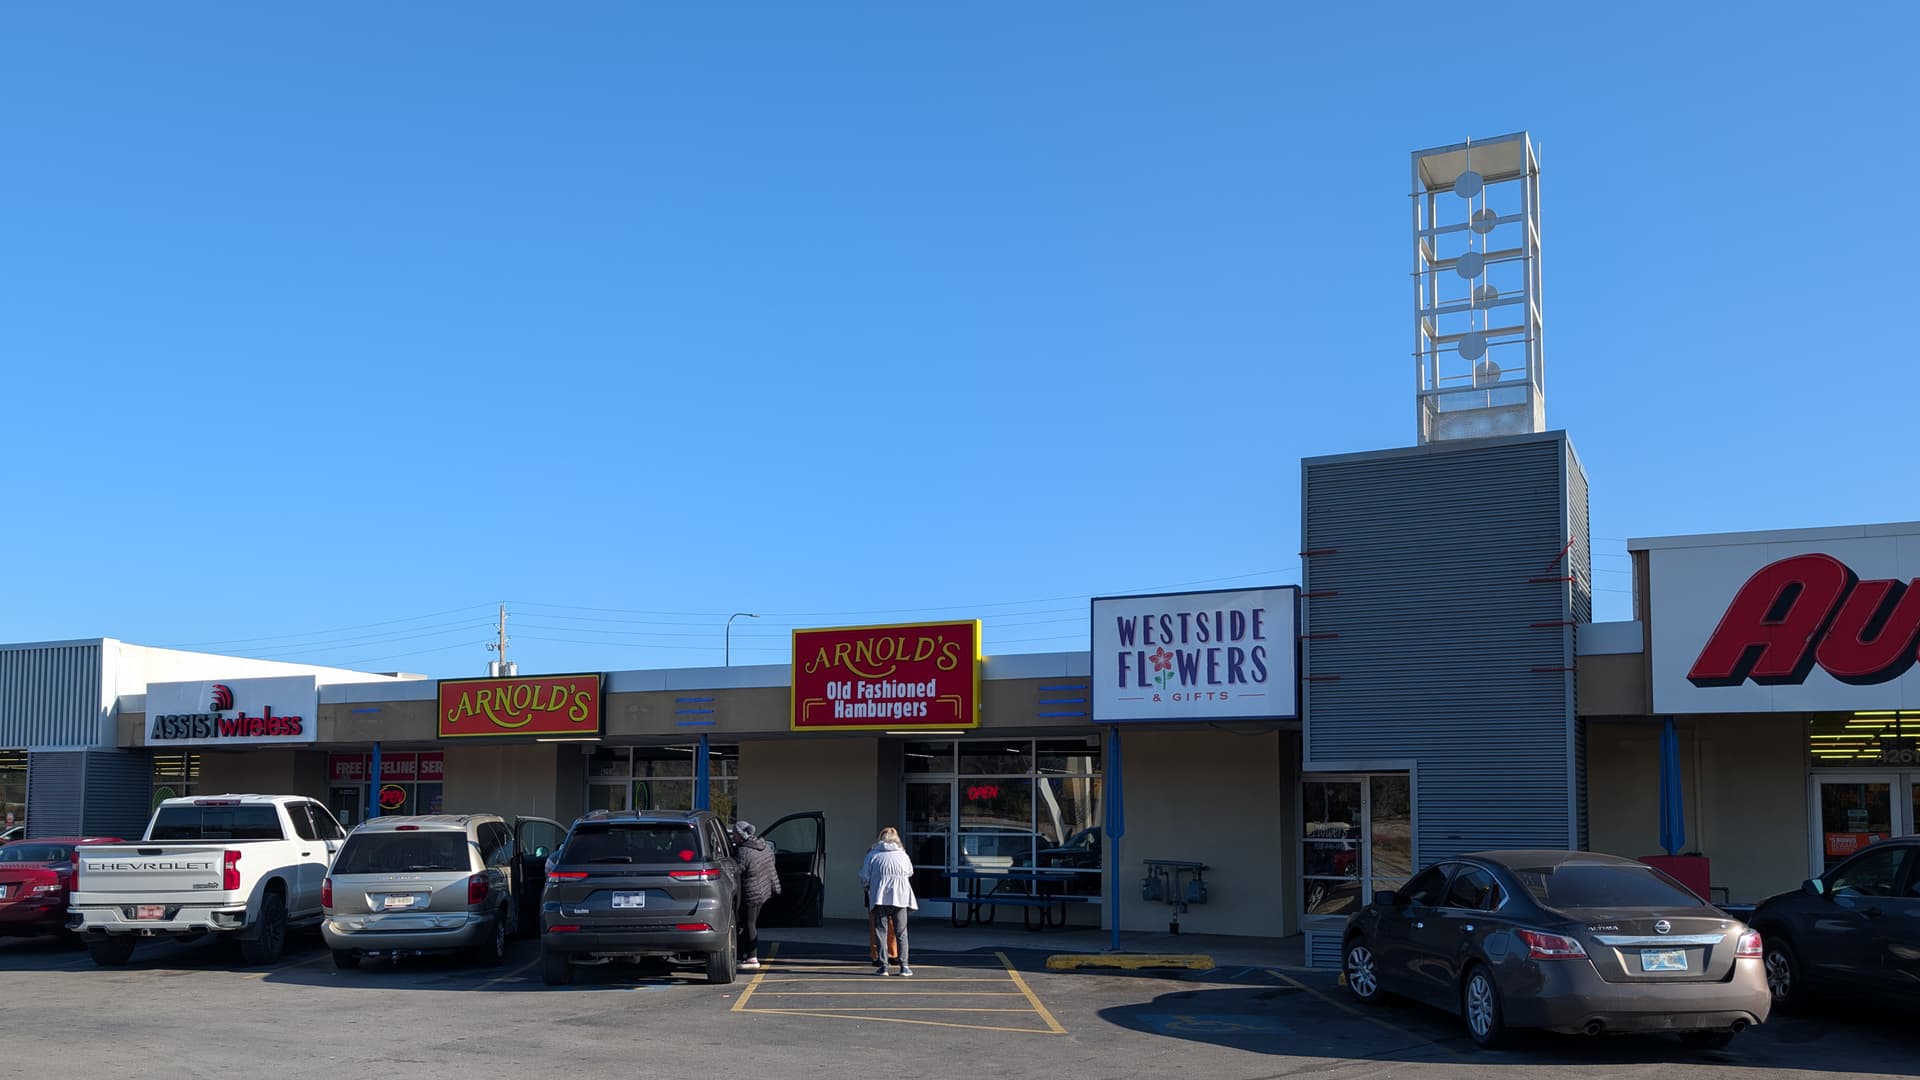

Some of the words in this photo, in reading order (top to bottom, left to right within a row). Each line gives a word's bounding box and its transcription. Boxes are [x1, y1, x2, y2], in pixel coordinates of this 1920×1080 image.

[1117, 608, 1267, 648] WESTSIDE
[1686, 553, 1920, 688] Au
[805, 635, 960, 679] ARNOLD'S
[827, 681, 851, 700] Old
[857, 678, 936, 699] Fashioned
[1153, 693, 1161, 702] &
[1172, 691, 1229, 701] GIFTS
[448, 684, 592, 728] ARNOLD'S
[834, 700, 927, 719] Hamburgers
[336, 762, 362, 774] FREE
[368, 761, 416, 774] LFELINE
[967, 785, 999, 800] OPEN
[88, 862, 214, 871] CHEVROLET
